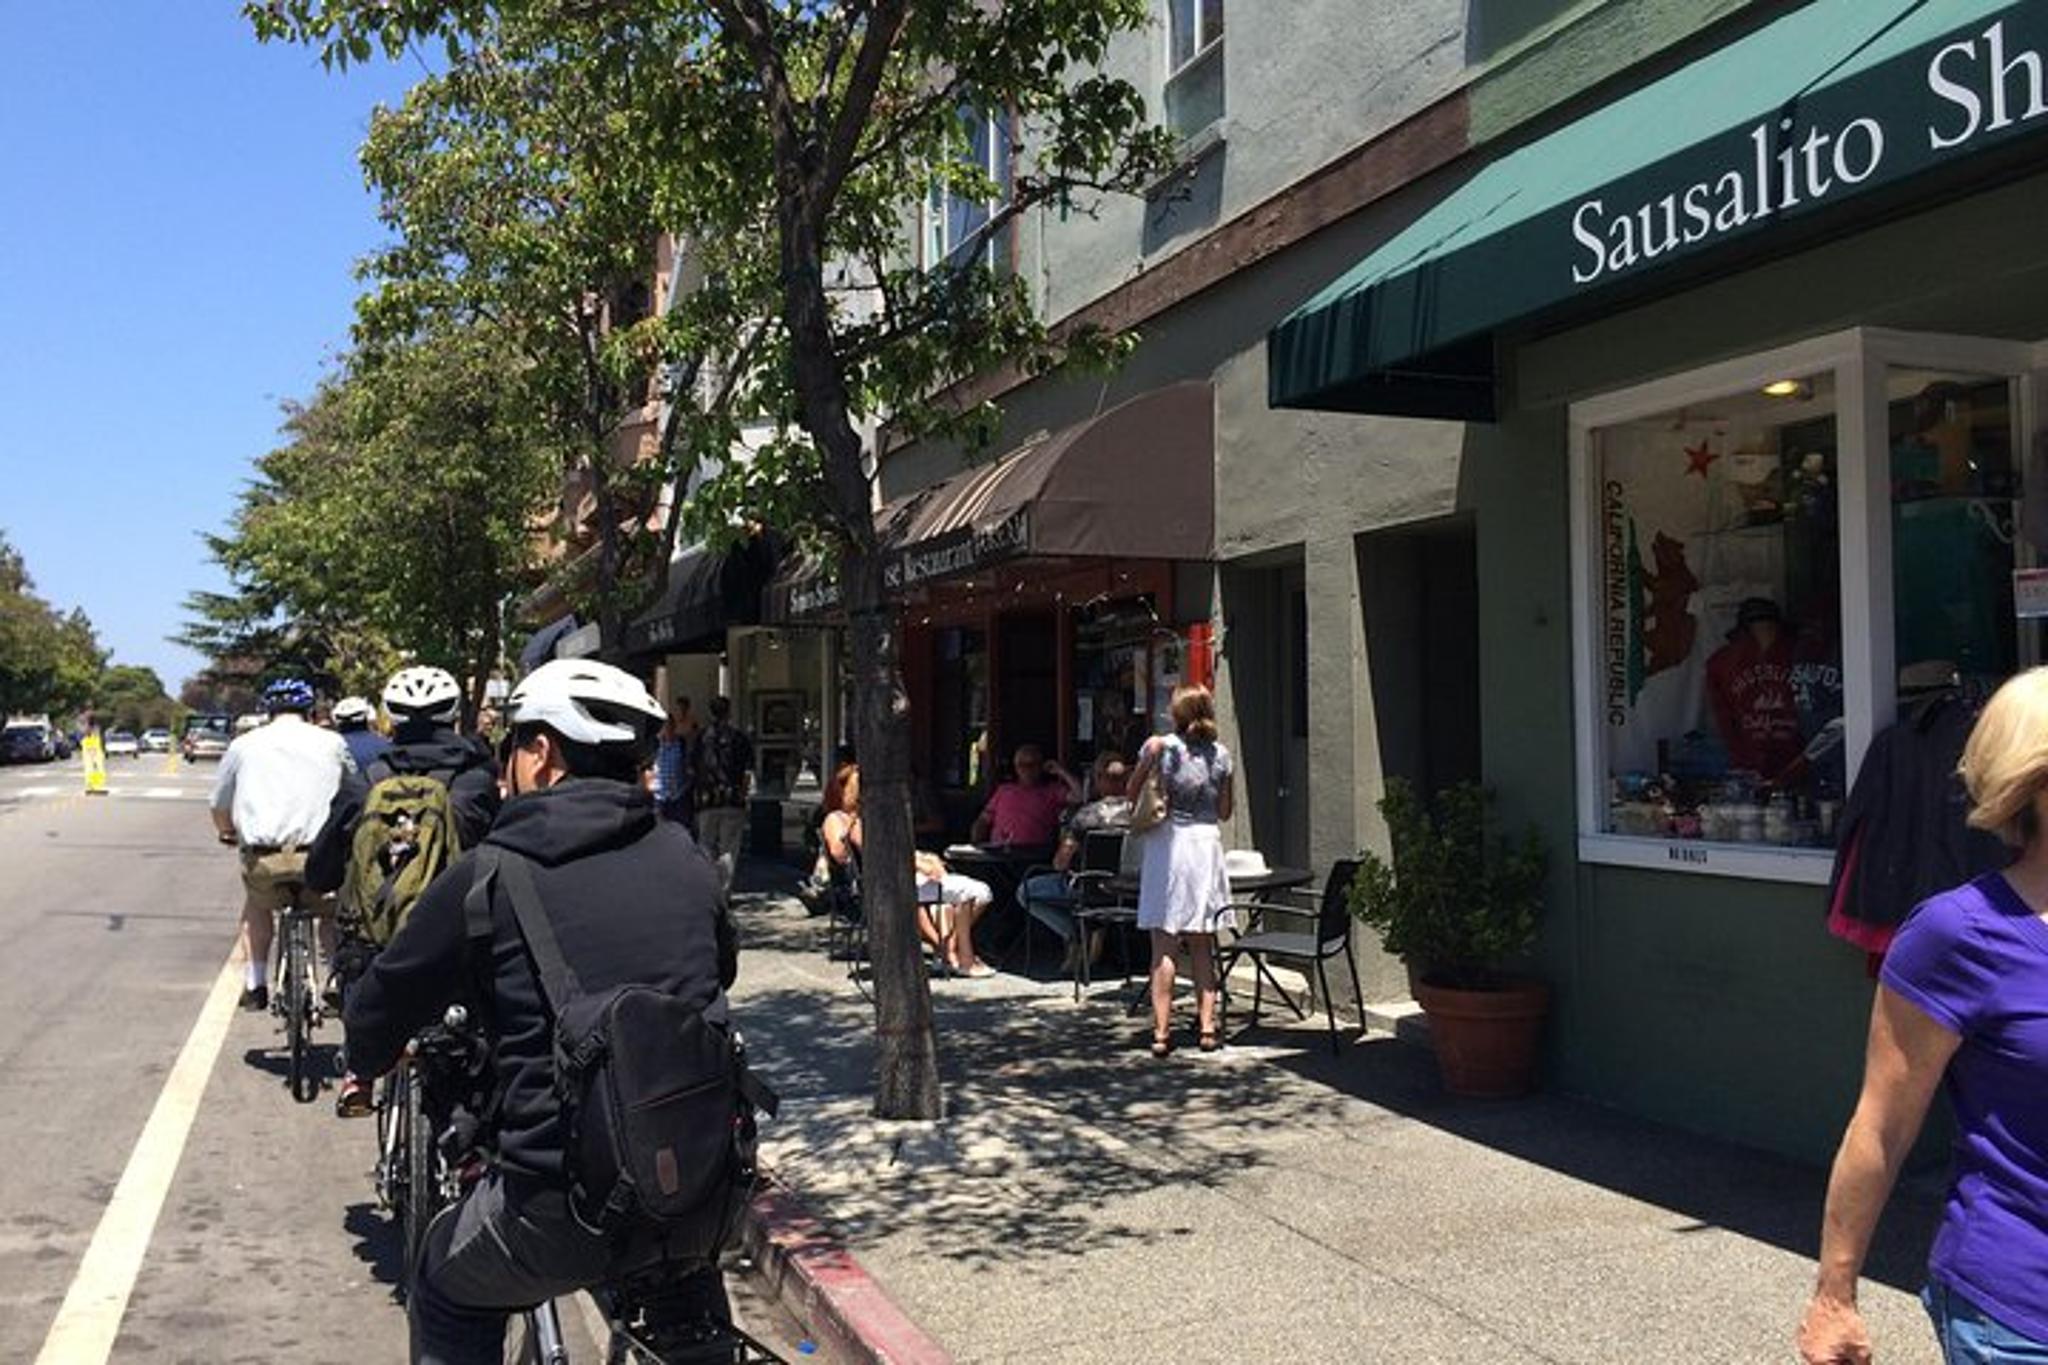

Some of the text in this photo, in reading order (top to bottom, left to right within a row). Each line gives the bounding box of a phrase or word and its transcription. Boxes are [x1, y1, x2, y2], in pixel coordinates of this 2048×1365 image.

[1571, 117, 1884, 284] Sausalito
[1606, 481, 1625, 727] CALIFORNIA REPUBLIC
